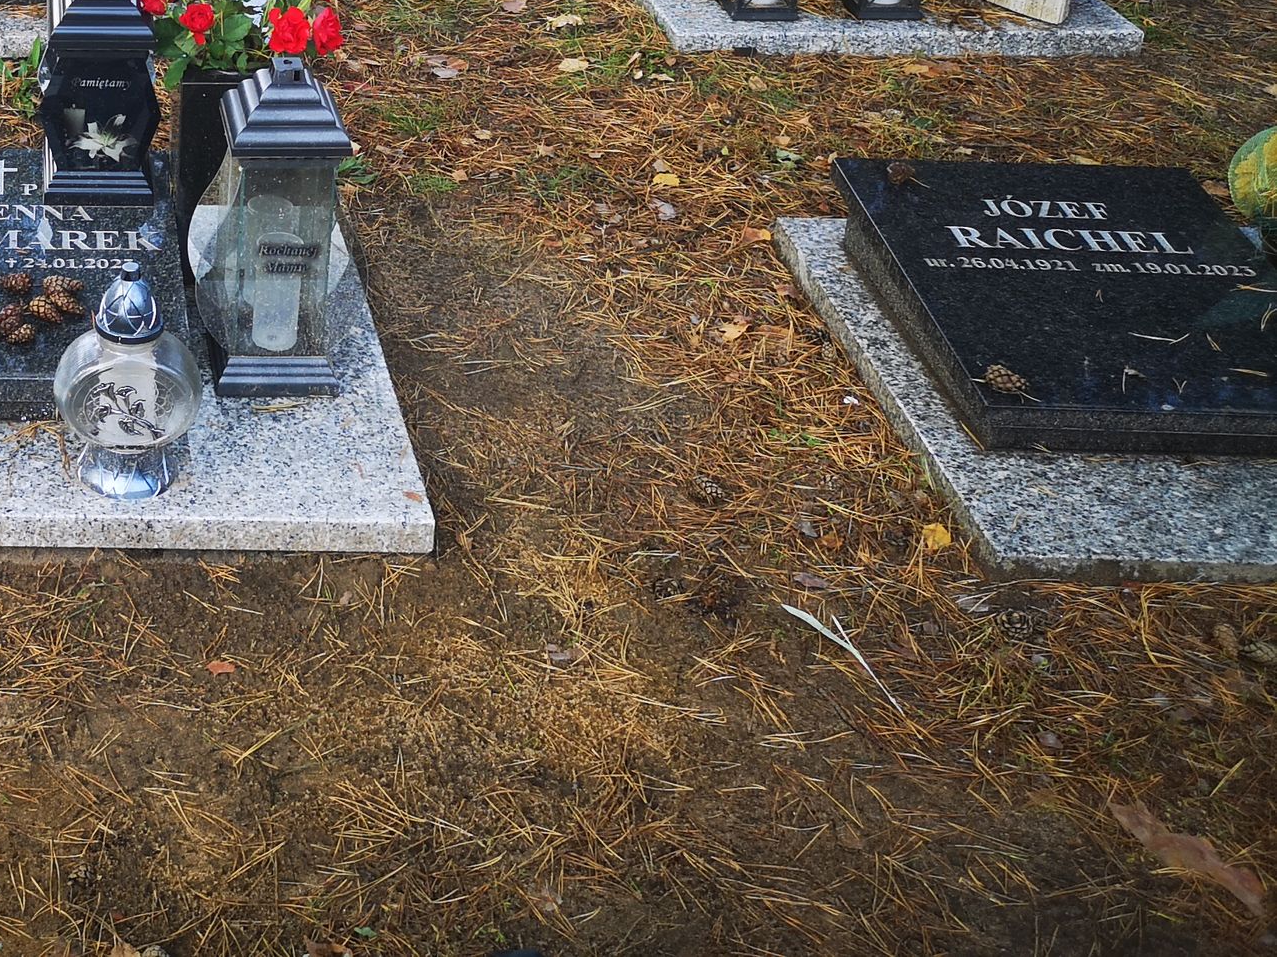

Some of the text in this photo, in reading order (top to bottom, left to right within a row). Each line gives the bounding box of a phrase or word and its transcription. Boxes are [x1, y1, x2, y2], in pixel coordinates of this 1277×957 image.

[981, 194, 1108, 220] JÓZEF
[943, 225, 1195, 255] RAICHEL
[25, 257, 134, 269] 24.01.202
[923, 255, 1257, 277] ur. 26.04.1921 zm. 19.01.2023
